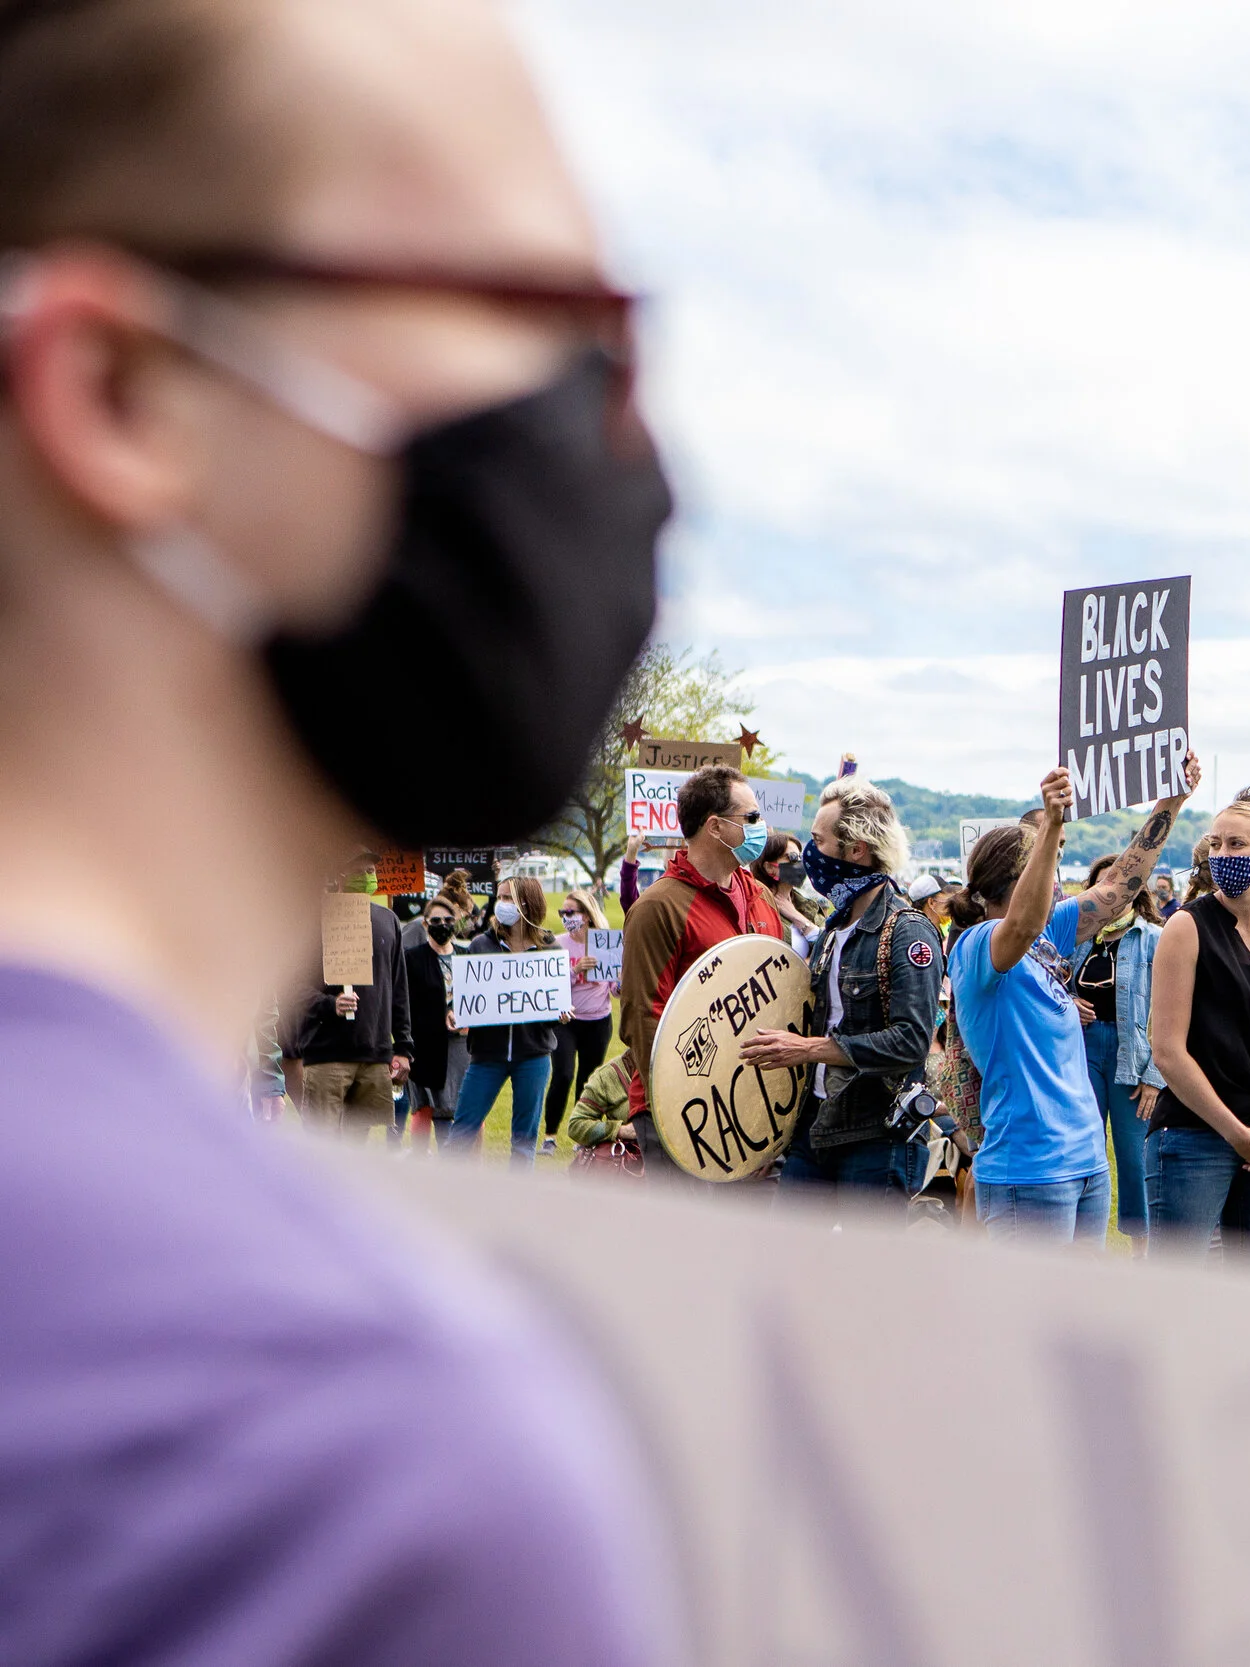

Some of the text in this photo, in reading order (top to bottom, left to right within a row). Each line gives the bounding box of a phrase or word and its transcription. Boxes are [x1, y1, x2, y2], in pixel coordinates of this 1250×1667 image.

[1080, 589, 1170, 664] BLACK
[1080, 658, 1163, 738] LIVES
[1067, 726, 1192, 822] MATTER
[755, 789, 801, 813] Matter
[630, 801, 680, 831] ENO
[433, 852, 488, 865] SILENCE
[465, 960, 493, 984] NO
[501, 956, 567, 980] JUSTICE
[698, 956, 723, 985] BLM
[458, 988, 560, 1017] NO PEACE
